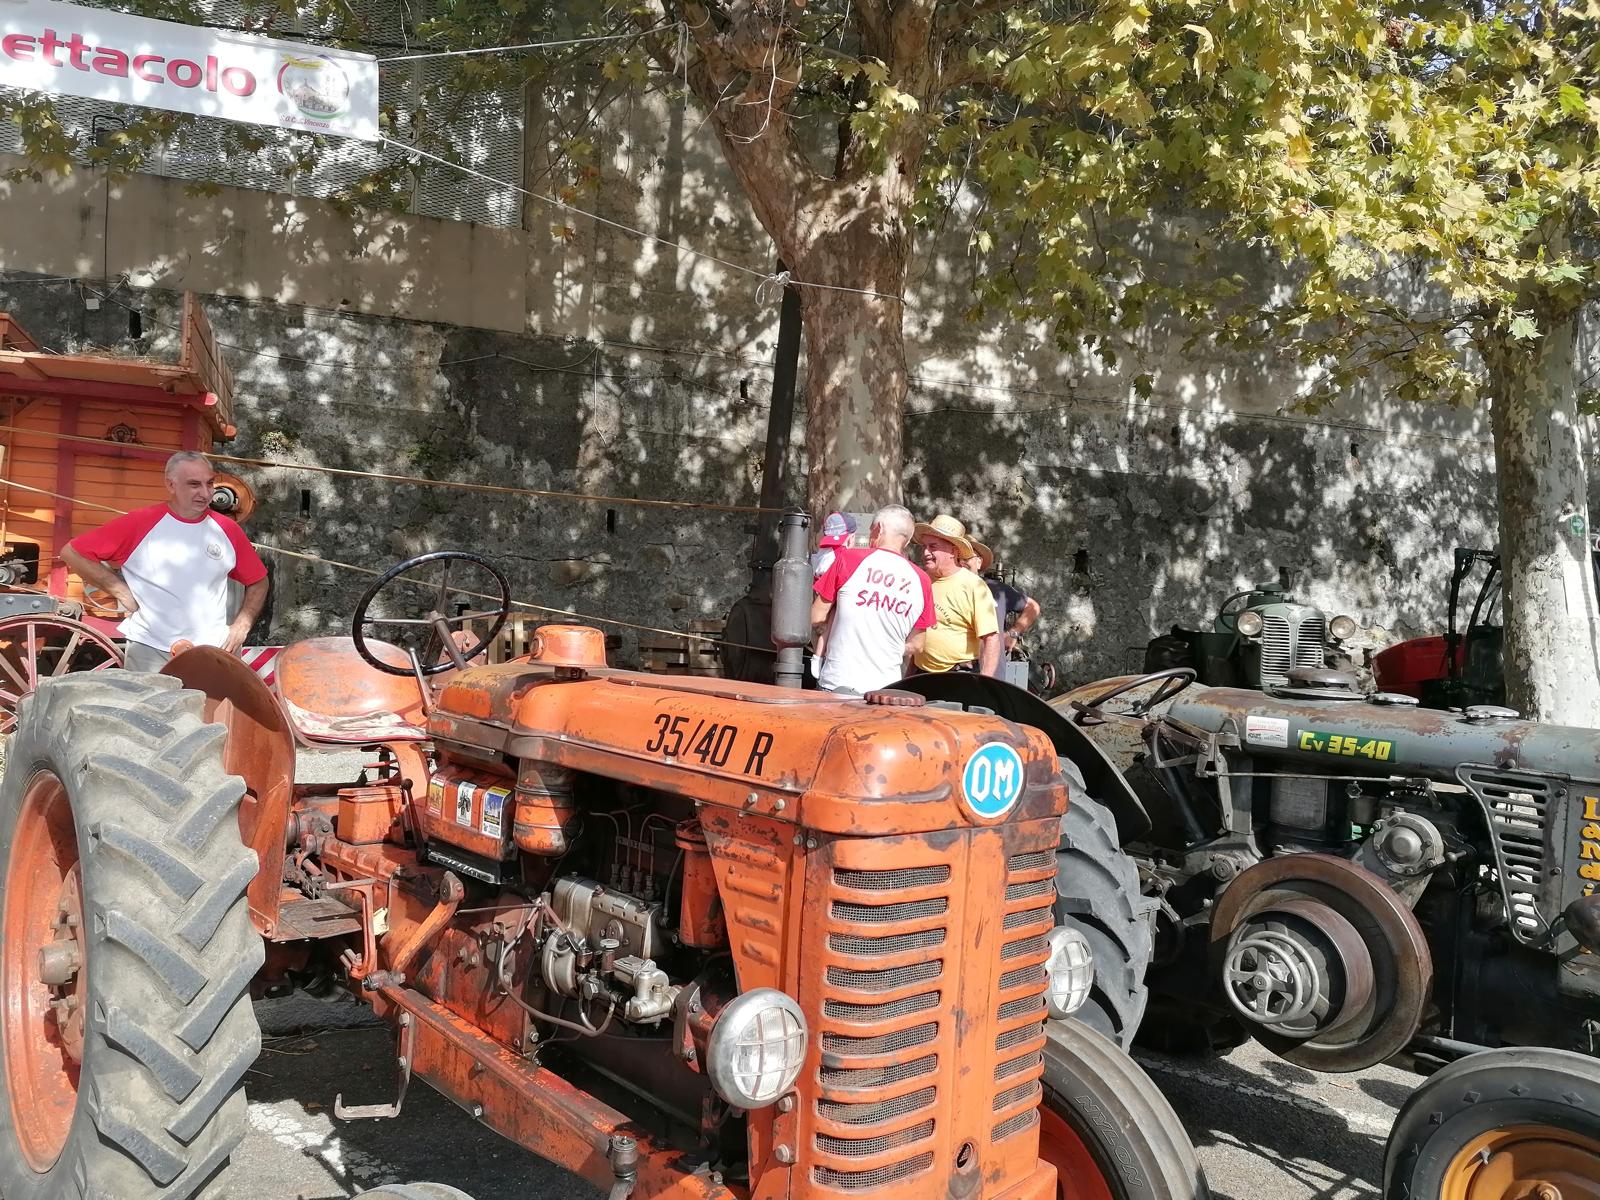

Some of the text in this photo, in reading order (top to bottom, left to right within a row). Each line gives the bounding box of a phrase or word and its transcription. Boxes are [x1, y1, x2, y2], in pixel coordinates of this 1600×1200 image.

[1, 28, 257, 97] ettacolo
[866, 567, 912, 594] 100 %
[646, 713, 774, 776] 35/40 R
[1300, 731, 1324, 751] Cv
[1327, 735, 1392, 761] 35-40
[971, 755, 1015, 802] OM
[1074, 1095, 1143, 1187] NYLON
